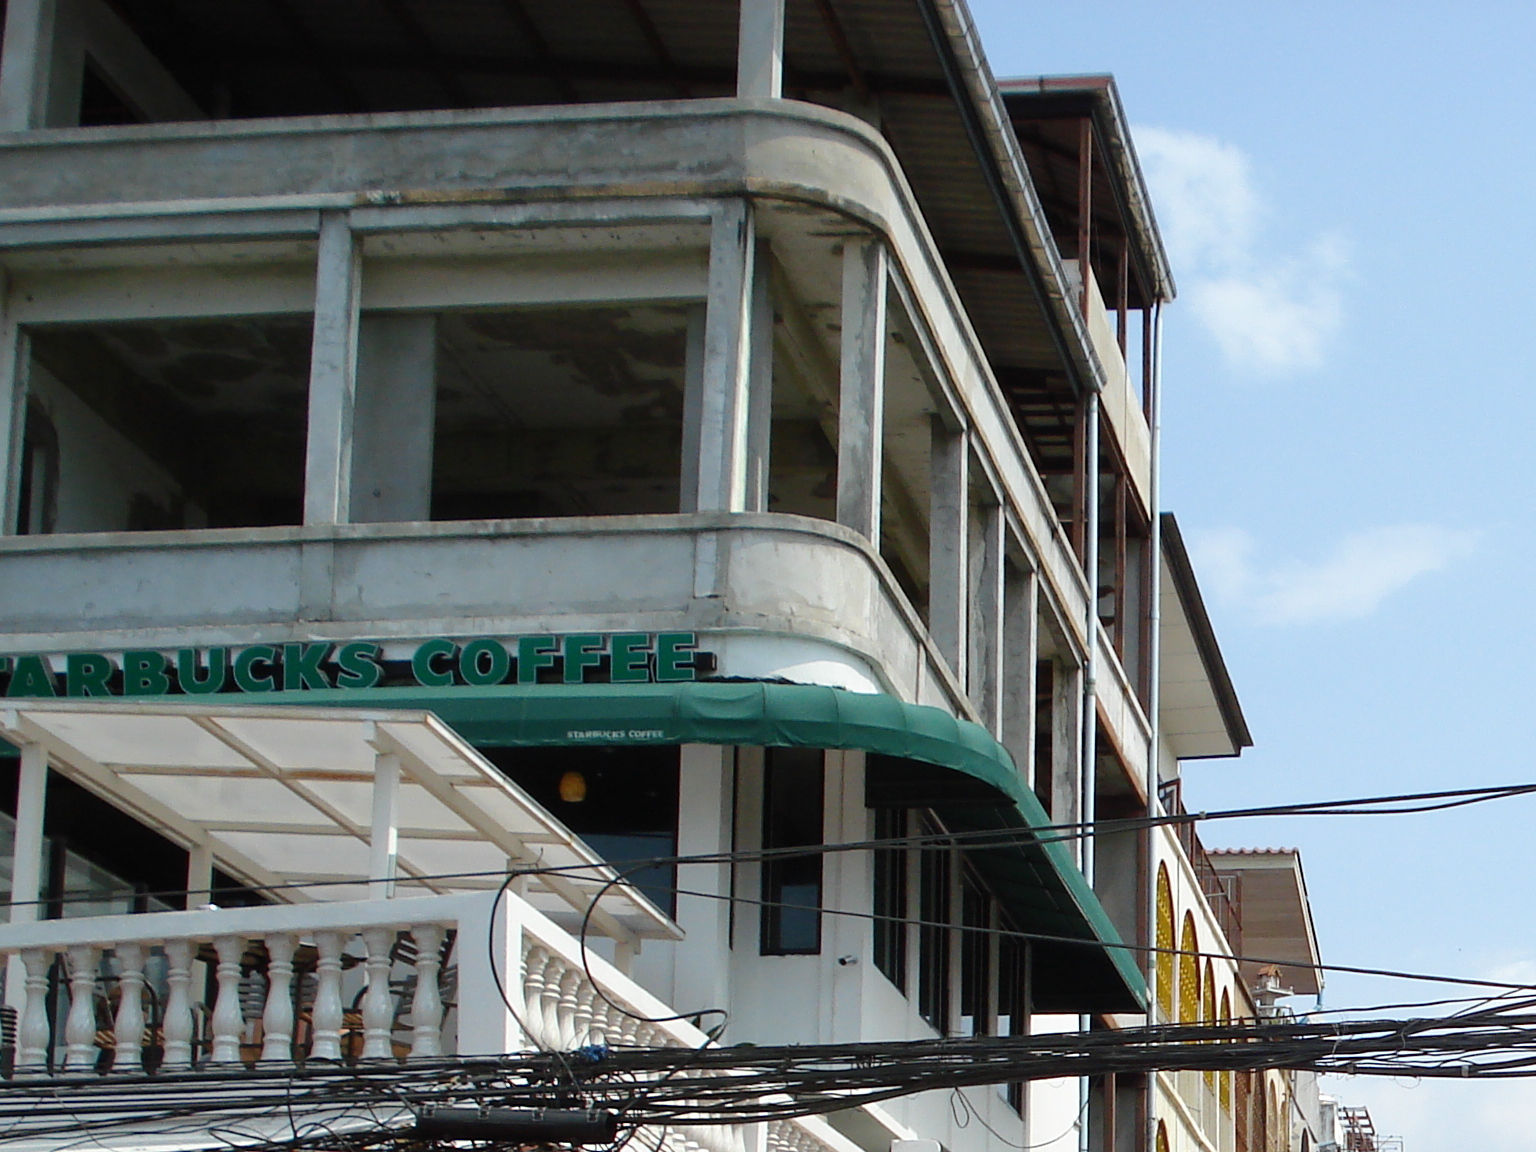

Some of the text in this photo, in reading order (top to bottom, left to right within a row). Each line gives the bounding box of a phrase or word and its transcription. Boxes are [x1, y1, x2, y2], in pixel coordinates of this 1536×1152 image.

[411, 632, 696, 687] COFFEE
[566, 729, 664, 740] STARBUCKS COFFEE
